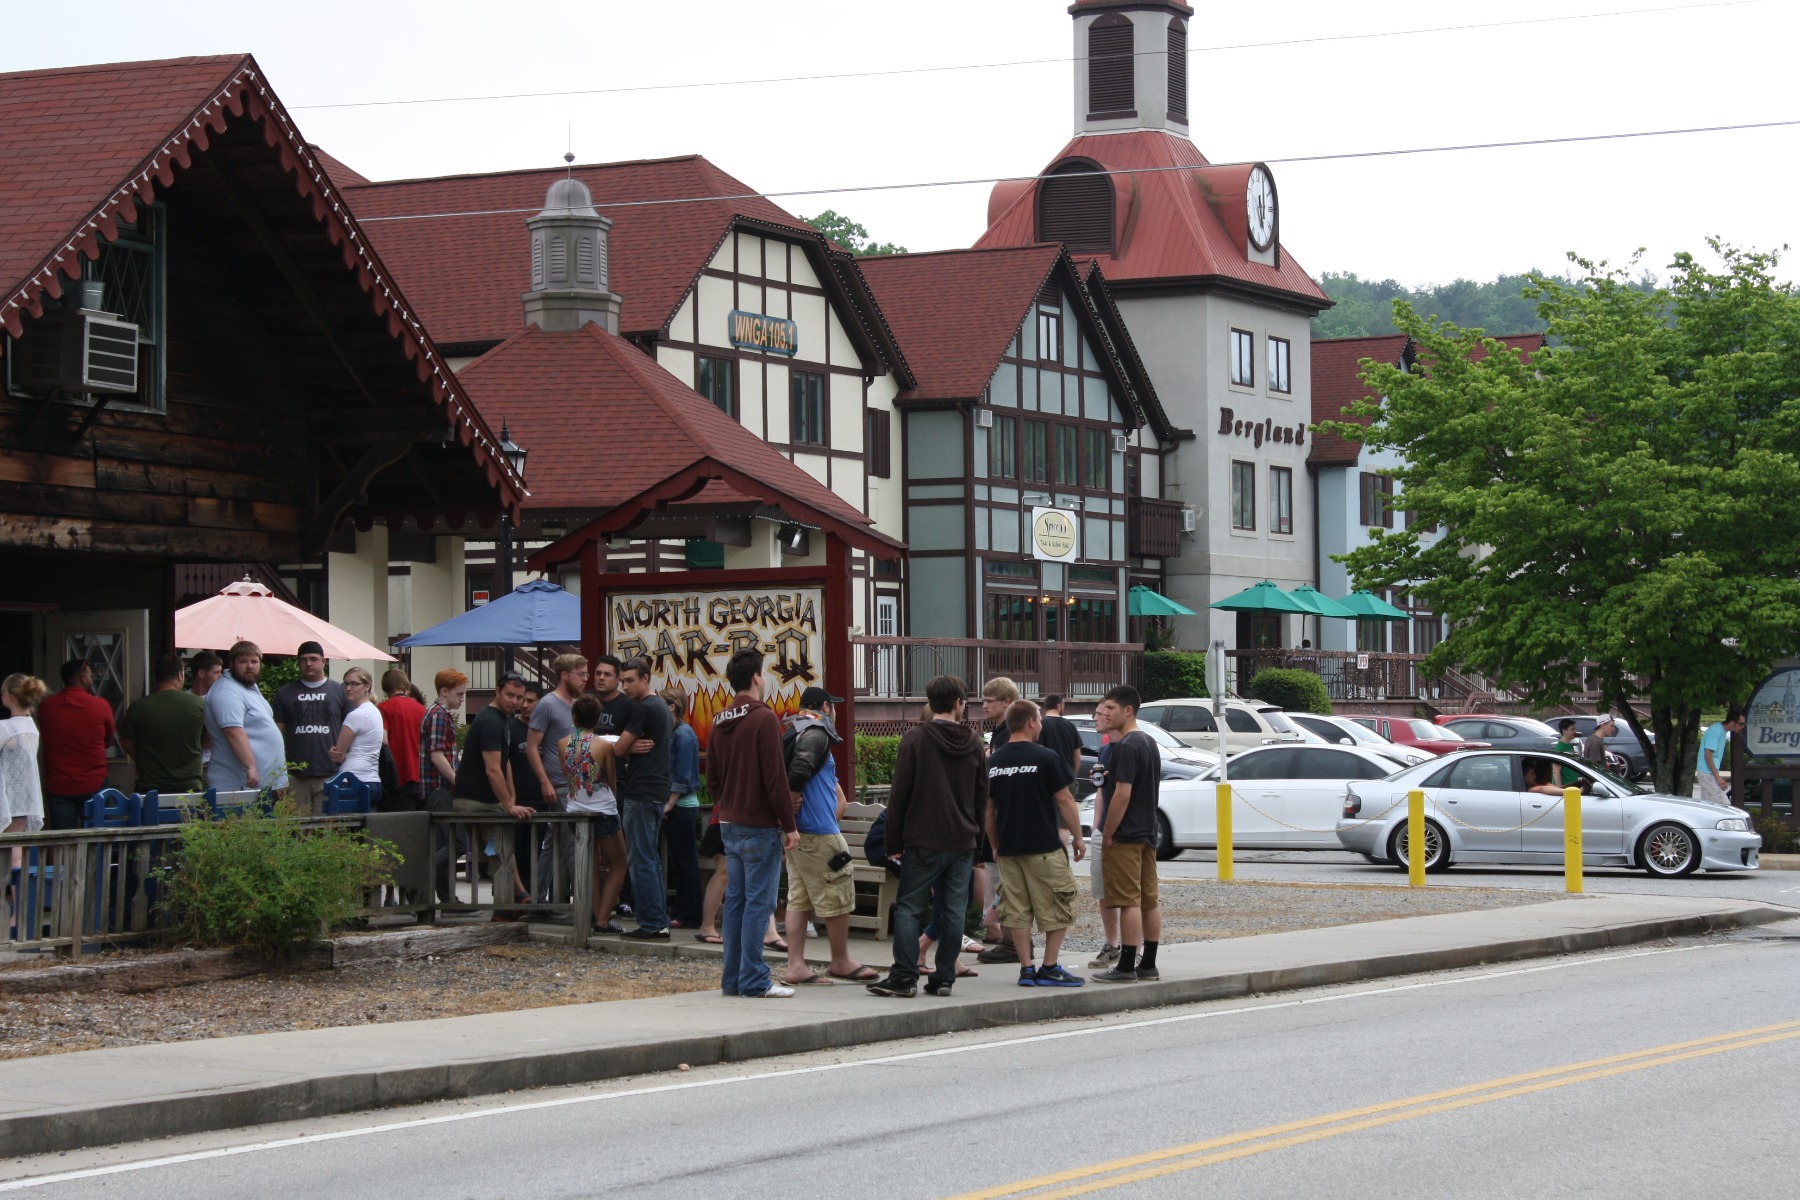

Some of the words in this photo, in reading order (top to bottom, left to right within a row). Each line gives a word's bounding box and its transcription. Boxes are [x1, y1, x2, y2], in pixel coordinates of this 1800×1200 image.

[735, 315, 767, 347] WNGA
[769, 321, 794, 350] 105.1
[1217, 406, 1305, 449] Bergland
[615, 596, 700, 632] NORTH
[708, 592, 817, 633] GEORGIA
[297, 693, 326, 701] CANT
[295, 724, 330, 734] ALONG
[1757, 726, 1800, 748] Berg
[989, 765, 1037, 779] Snap-on
